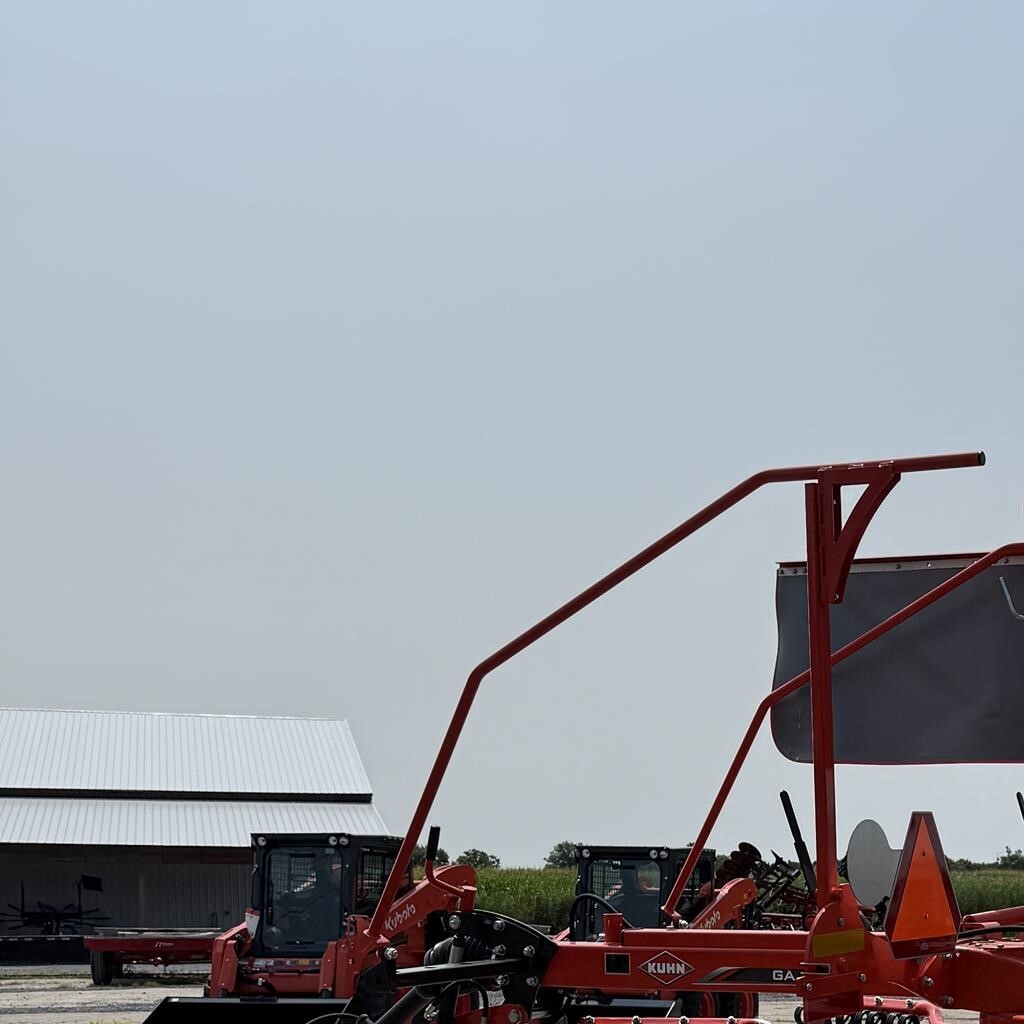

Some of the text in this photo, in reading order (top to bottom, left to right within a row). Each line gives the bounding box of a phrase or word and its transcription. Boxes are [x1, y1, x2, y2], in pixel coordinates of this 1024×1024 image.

[385, 904, 416, 931] Kubota
[698, 910, 720, 929] bota
[647, 962, 686, 974] KUHN
[772, 969, 796, 981] GA
